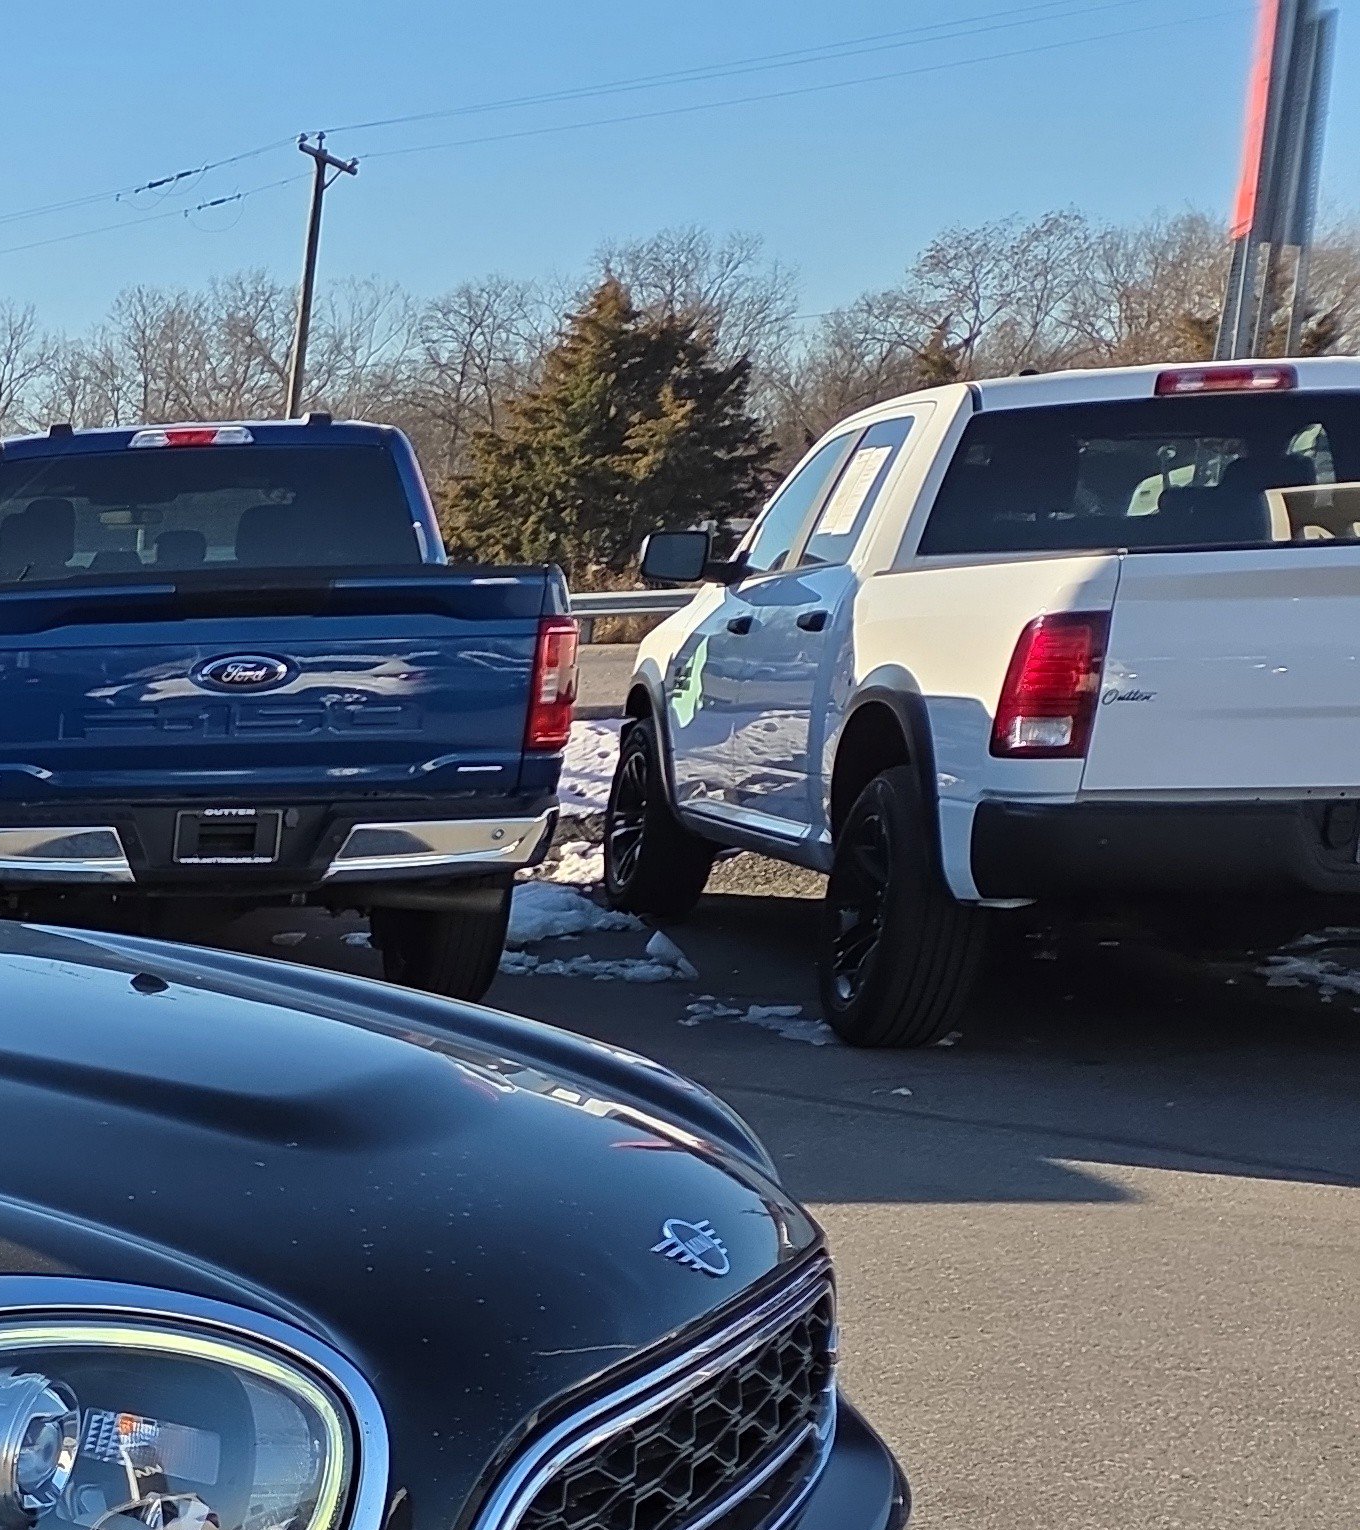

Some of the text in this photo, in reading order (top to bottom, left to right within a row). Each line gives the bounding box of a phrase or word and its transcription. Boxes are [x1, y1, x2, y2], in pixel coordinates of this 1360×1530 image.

[221, 662, 268, 682] Ford
[58, 703, 424, 740] F-150
[203, 808, 257, 817] OUTTEN
